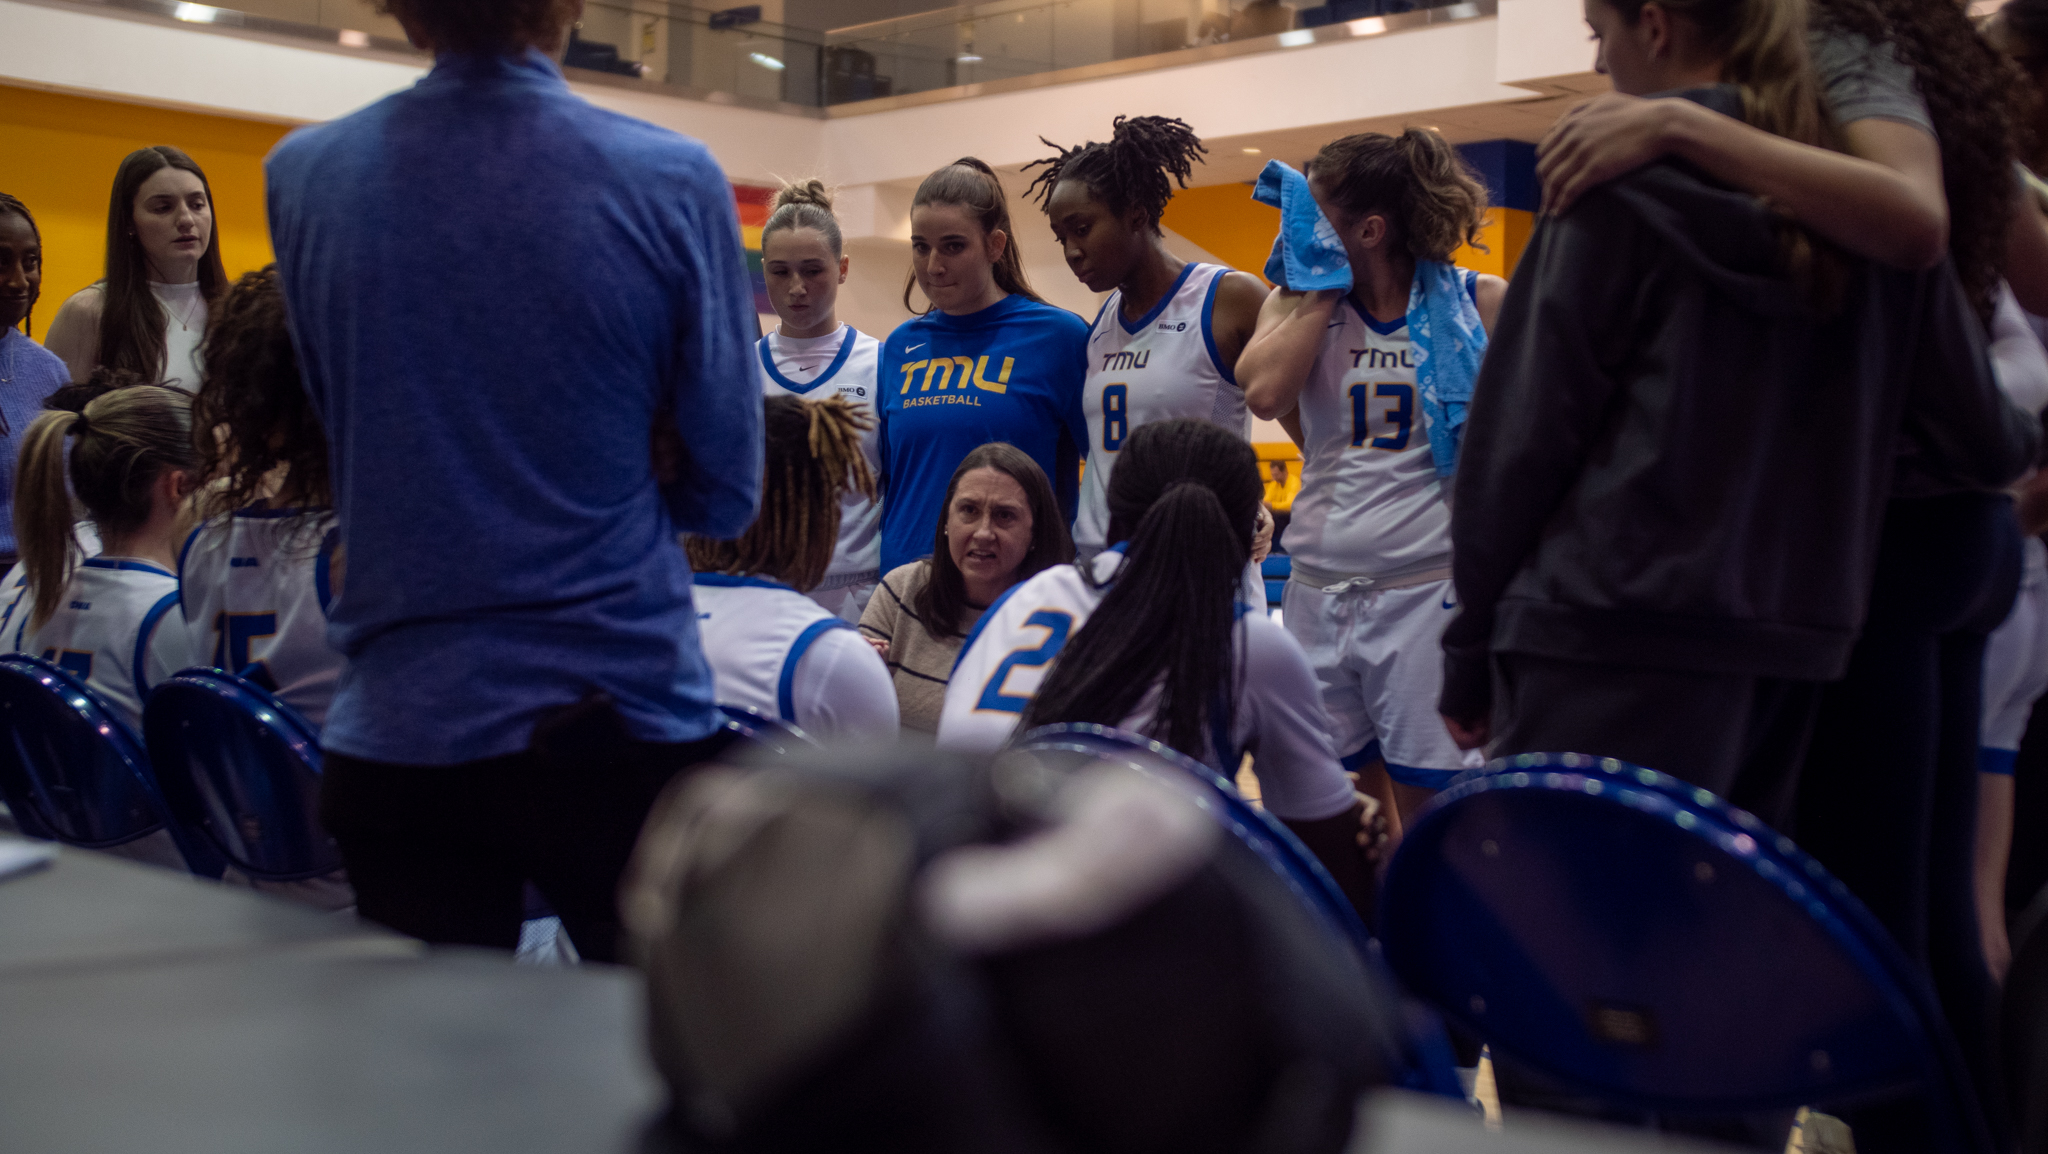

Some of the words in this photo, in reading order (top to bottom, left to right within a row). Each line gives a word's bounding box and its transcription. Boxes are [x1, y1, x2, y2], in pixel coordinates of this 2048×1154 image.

[900, 355, 1015, 395] TMU
[1102, 349, 1151, 371] TMU
[903, 394, 982, 409] BASKETBALL
[1102, 382, 1129, 453] 8
[1348, 382, 1415, 452] 13
